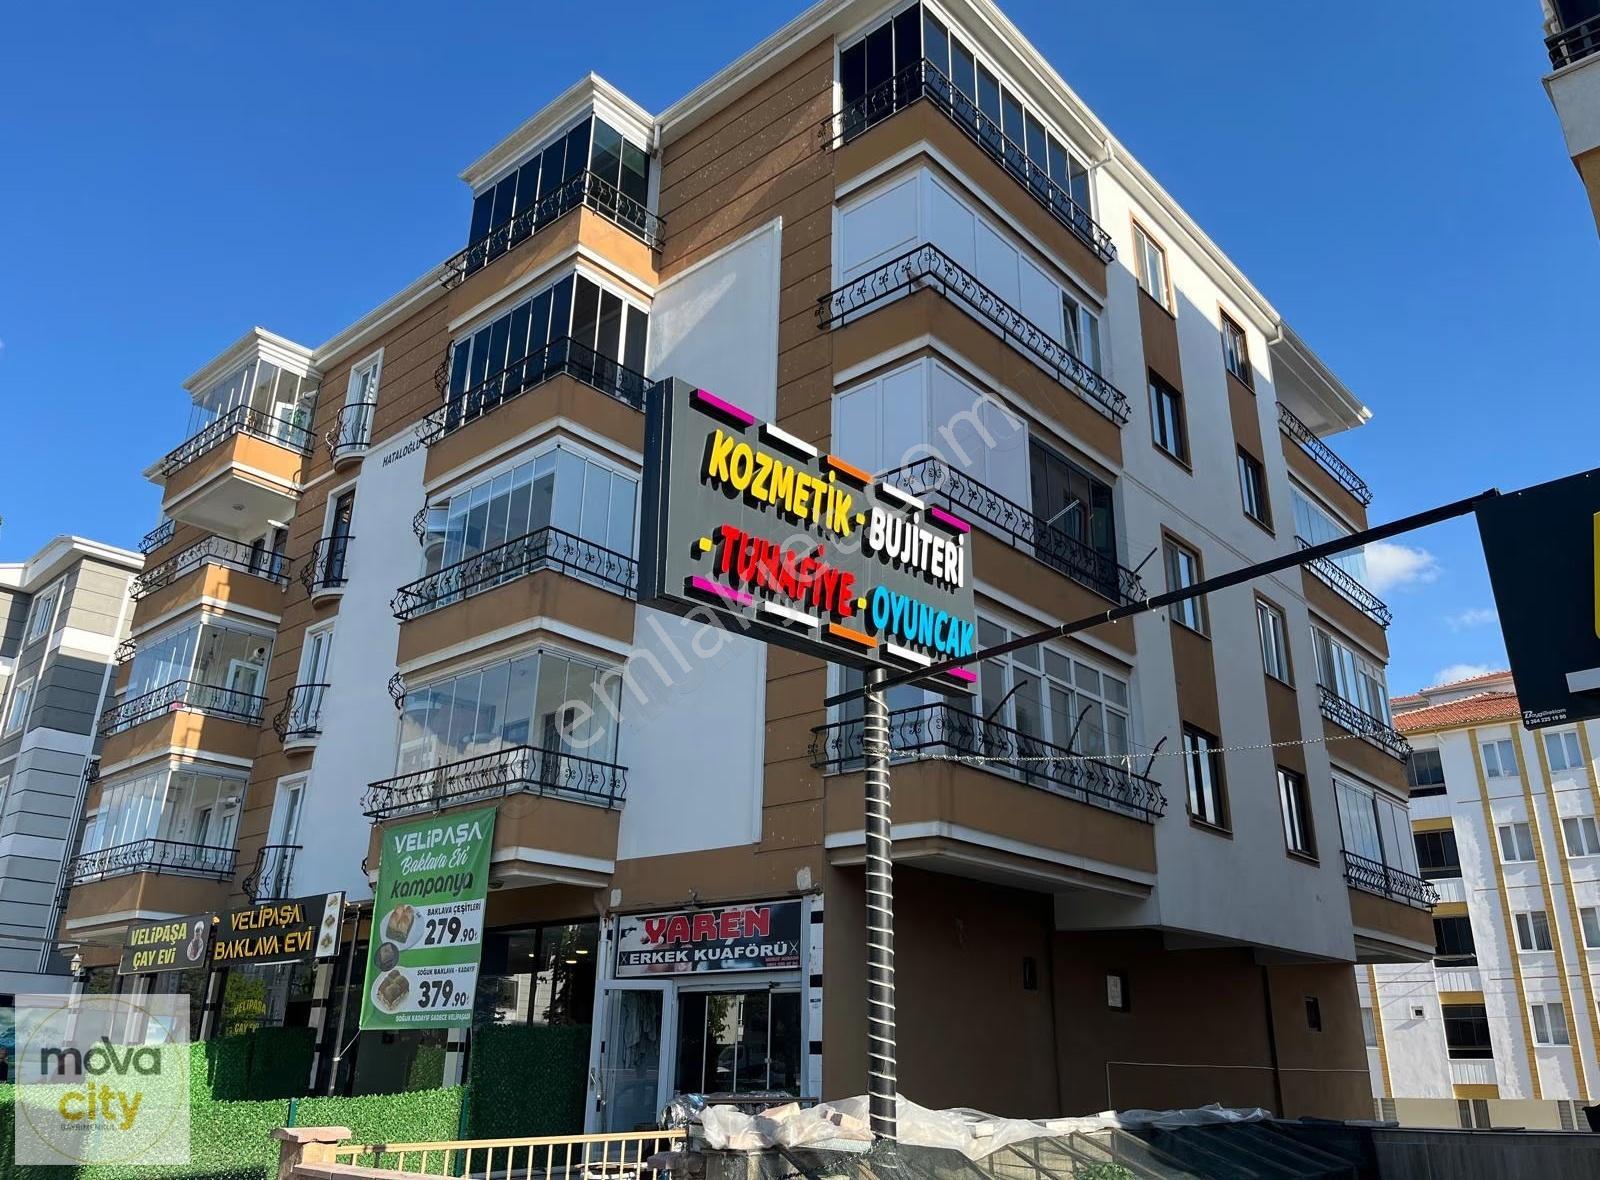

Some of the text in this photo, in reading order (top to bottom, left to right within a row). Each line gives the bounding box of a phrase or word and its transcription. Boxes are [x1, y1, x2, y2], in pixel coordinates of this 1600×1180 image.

[708, 429, 852, 536] KOZMETİK
[868, 506, 965, 588] BUJİTERİ
[720, 524, 856, 618] TUHAFİYE
[872, 585, 975, 658] OYUNCAK
[401, 846, 470, 876] Baklava Evi
[231, 904, 304, 931] VELİPAŞA
[427, 905, 453, 916] BAKLAVA
[643, 907, 771, 945] YAREN
[132, 947, 177, 971] ÇAY EVİ
[213, 926, 315, 961] BAKLAVA EVİ
[629, 941, 788, 965] ERKEK KUAFÖRÜ
[417, 967, 433, 976] SOĞUK
[434, 967, 455, 975] BAKLAVA
